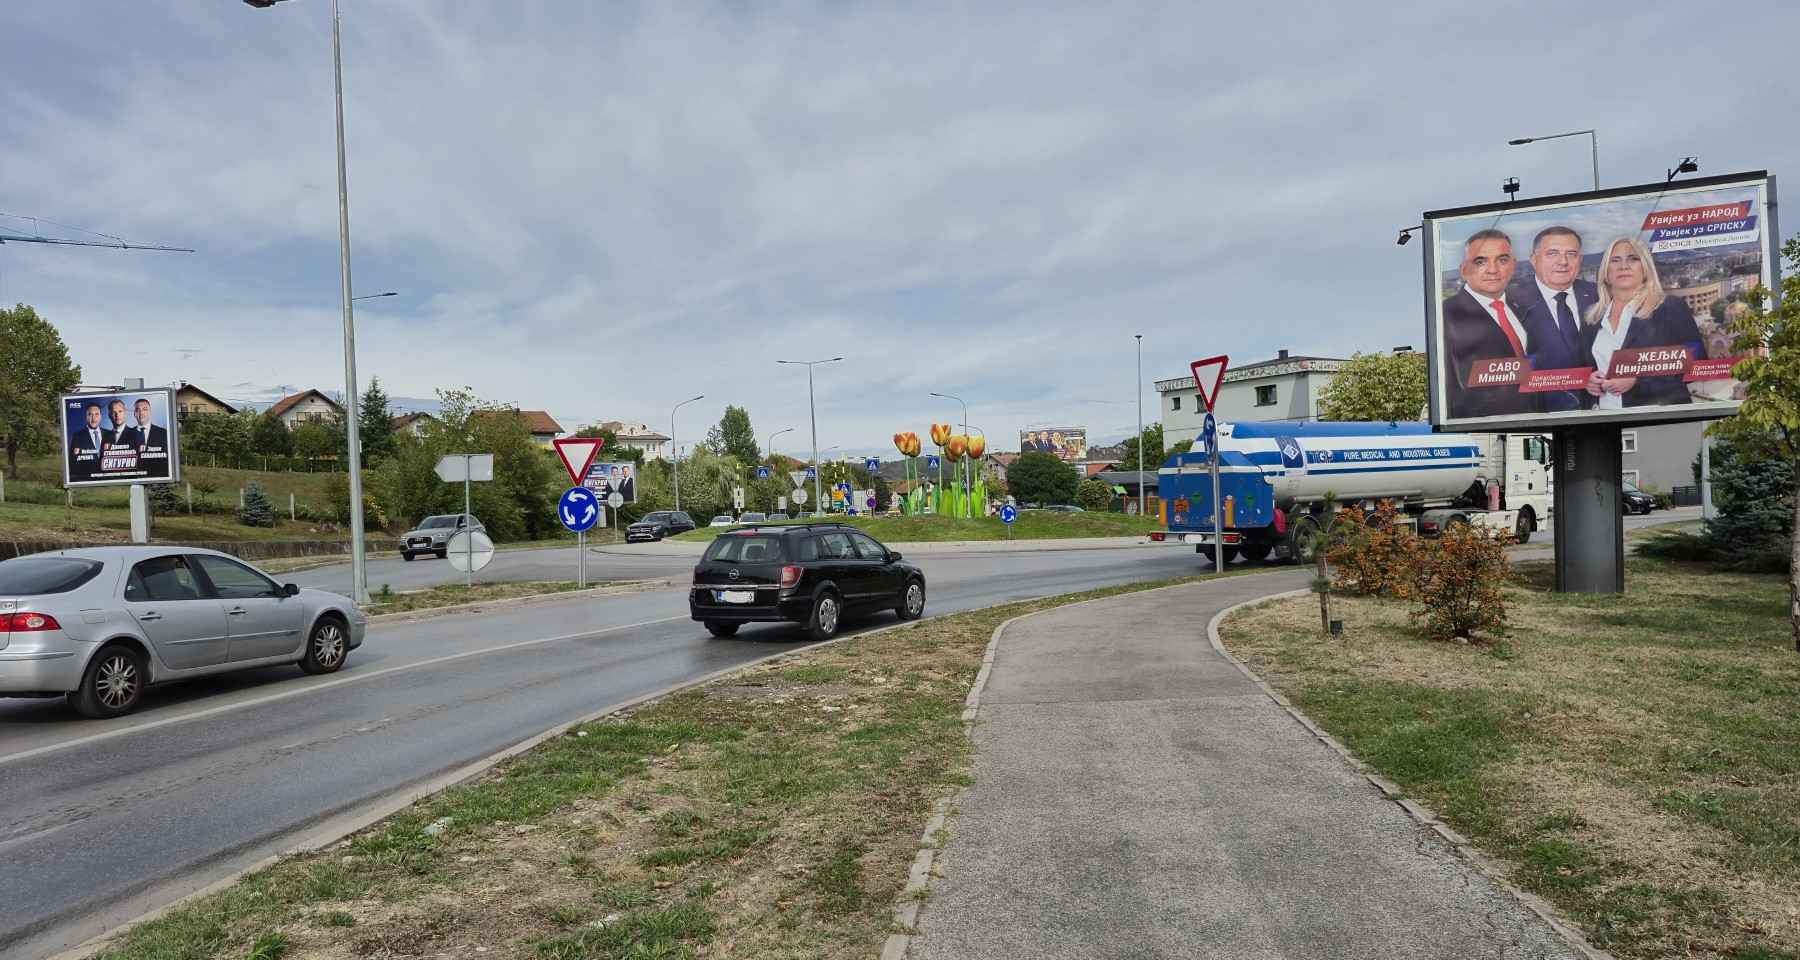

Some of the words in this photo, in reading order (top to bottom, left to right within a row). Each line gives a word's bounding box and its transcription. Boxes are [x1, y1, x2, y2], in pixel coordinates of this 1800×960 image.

[1650, 214, 1684, 225] Увијек
[1687, 214, 1698, 222] уз
[1702, 207, 1739, 218] НАРОД
[1660, 227, 1690, 238] Увијек
[1693, 226, 1704, 235] уз
[1707, 220, 1747, 231] СРПСКУ
[1638, 349, 1687, 362] ЖЕЉКА
[1489, 361, 1520, 373] САВО
[1615, 360, 1683, 375] Цвијановић
[1478, 371, 1515, 383] Минић
[1389, 450, 1401, 459] AND
[1402, 449, 1433, 458] INDUSTRIAL
[1433, 448, 1451, 457] GASES
